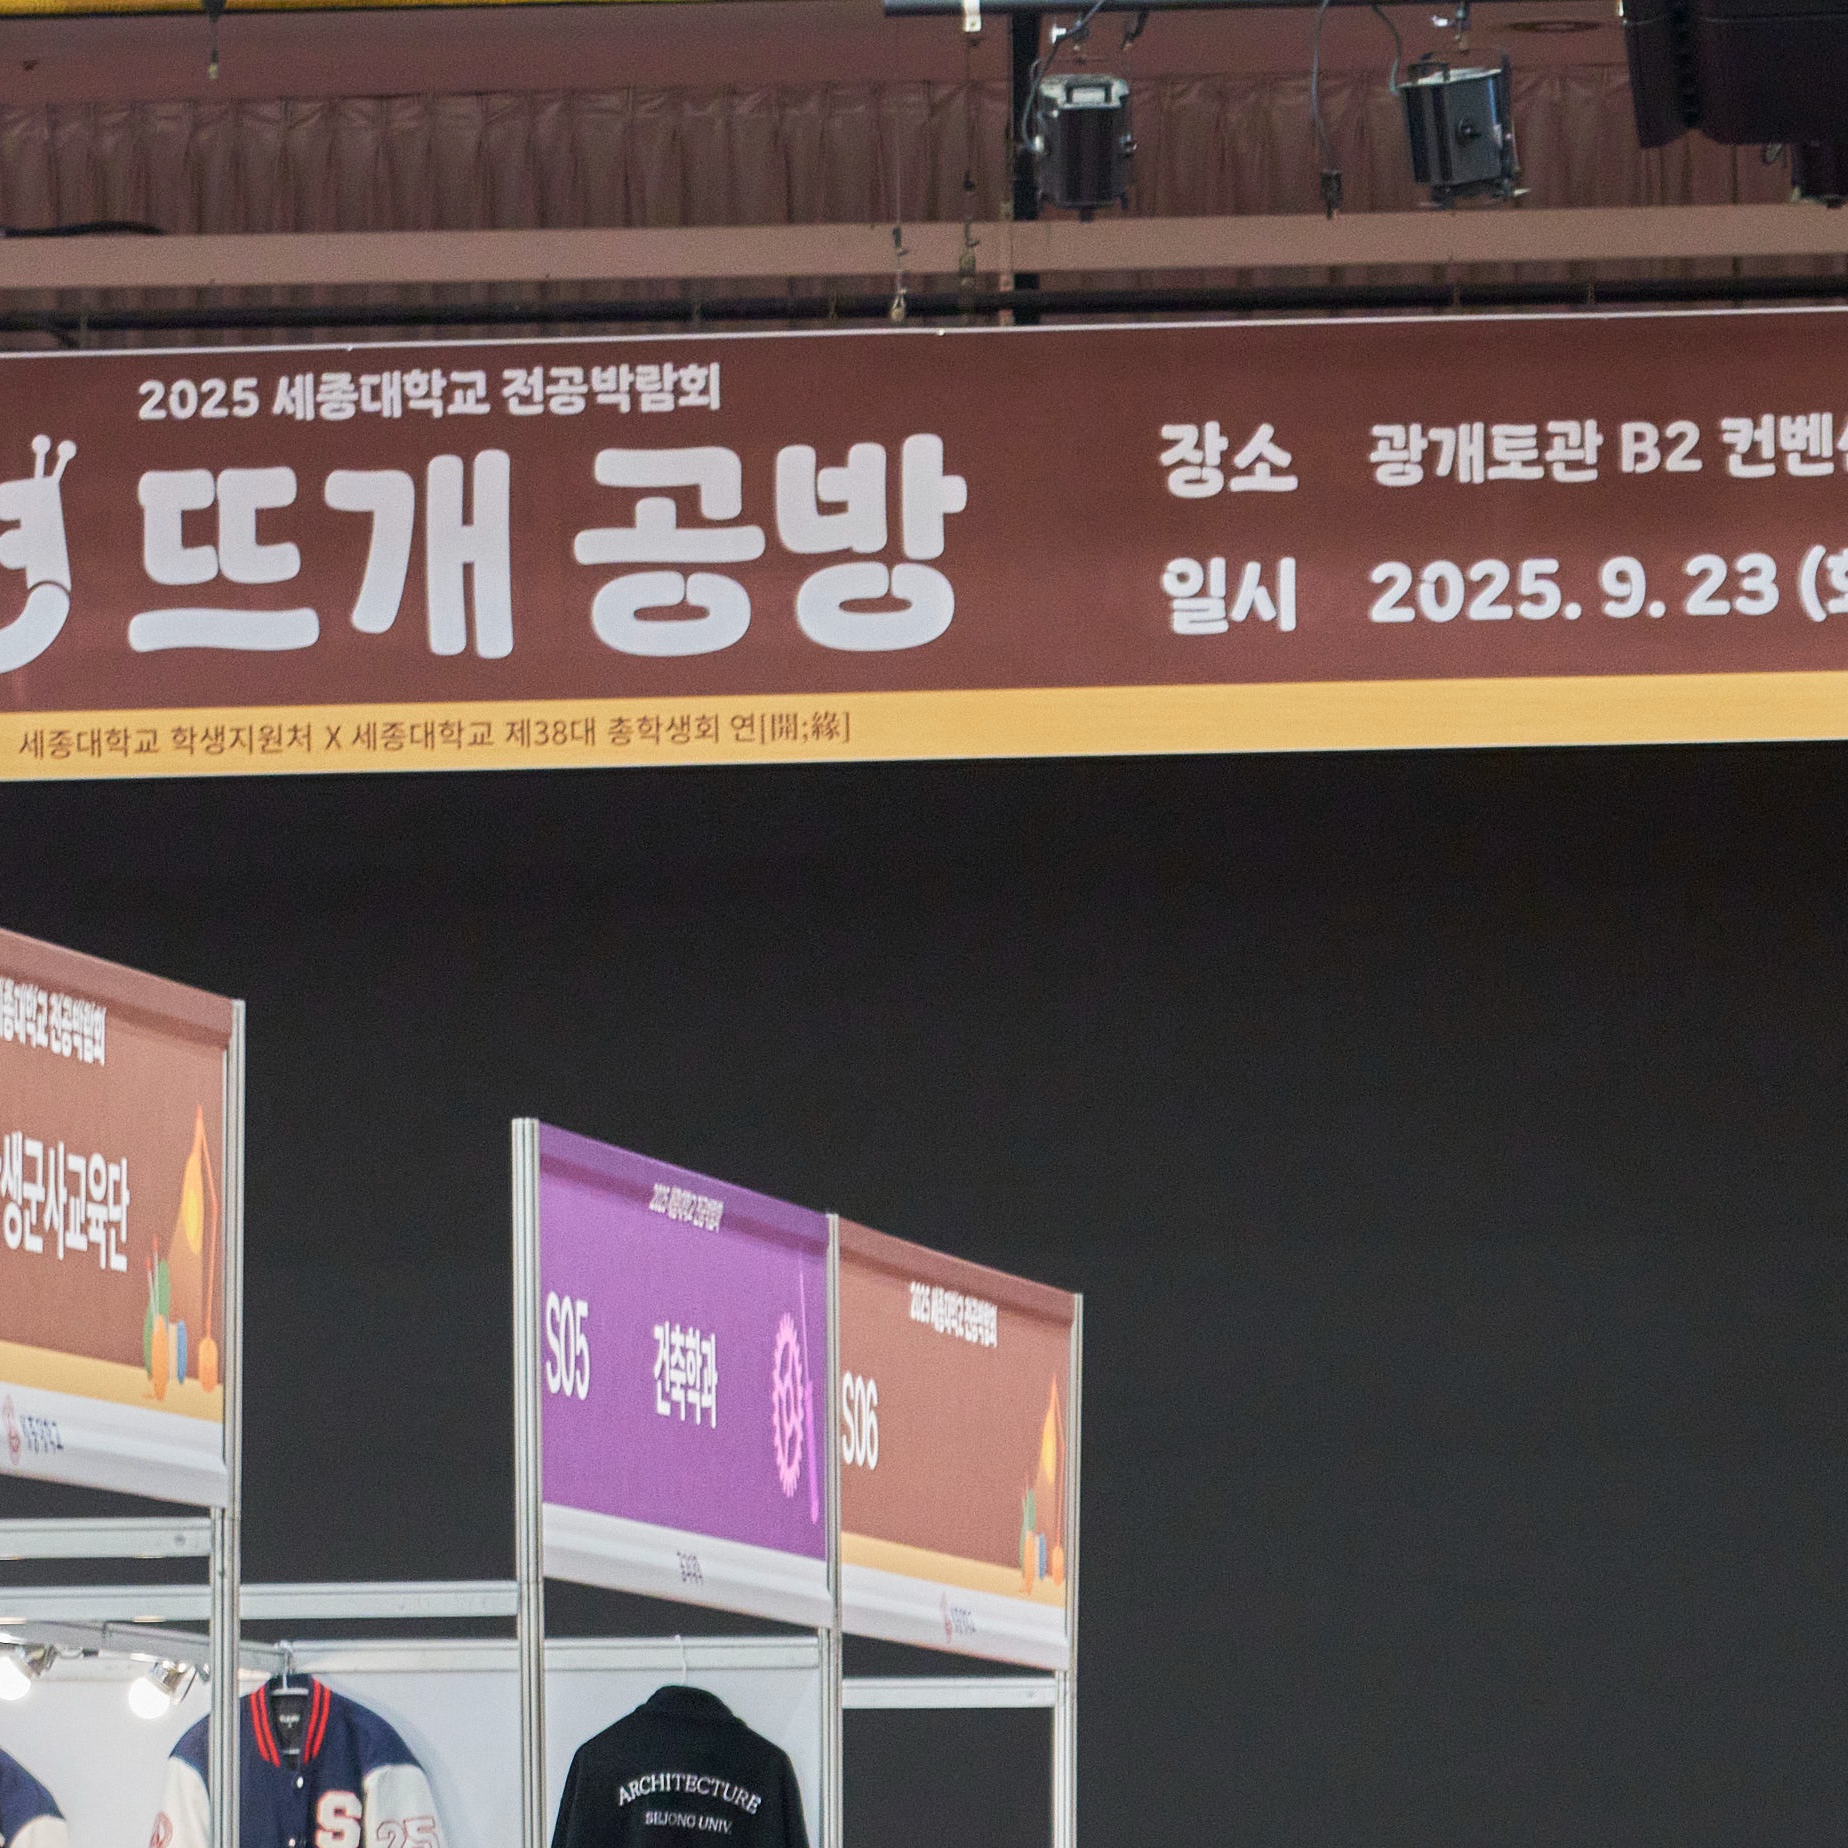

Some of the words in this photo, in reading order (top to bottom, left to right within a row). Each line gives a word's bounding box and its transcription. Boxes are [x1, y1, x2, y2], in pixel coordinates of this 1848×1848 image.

[138, 378, 259, 421] 2025
[272, 369, 491, 421] 세종대학교
[501, 362, 722, 415] 전공박람회
[1159, 421, 1298, 498] 장소
[1368, 419, 1602, 488] 광개토관
[1619, 424, 1703, 472] B2
[128, 449, 513, 660] 뜨개
[573, 433, 967, 657] 공방
[1161, 556, 1295, 635] 일시
[1368, 561, 1582, 624] 2025.
[1601, 560, 1667, 620] 9.
[1682, 555, 1779, 616] 23
[18, 728, 162, 760] 세종대학교
[171, 723, 315, 757] 학생지원처
[324, 726, 343, 752] X
[351, 718, 497, 751] 세종대학교
[505, 717, 596, 748] 제38대
[607, 714, 720, 747] 총학생회
[545, 1291, 590, 1401] S05
[653, 1320, 718, 1429] 건축학과
[841, 1371, 879, 1470] S06
[618, 1772, 762, 1815] ARCHITECTURE
